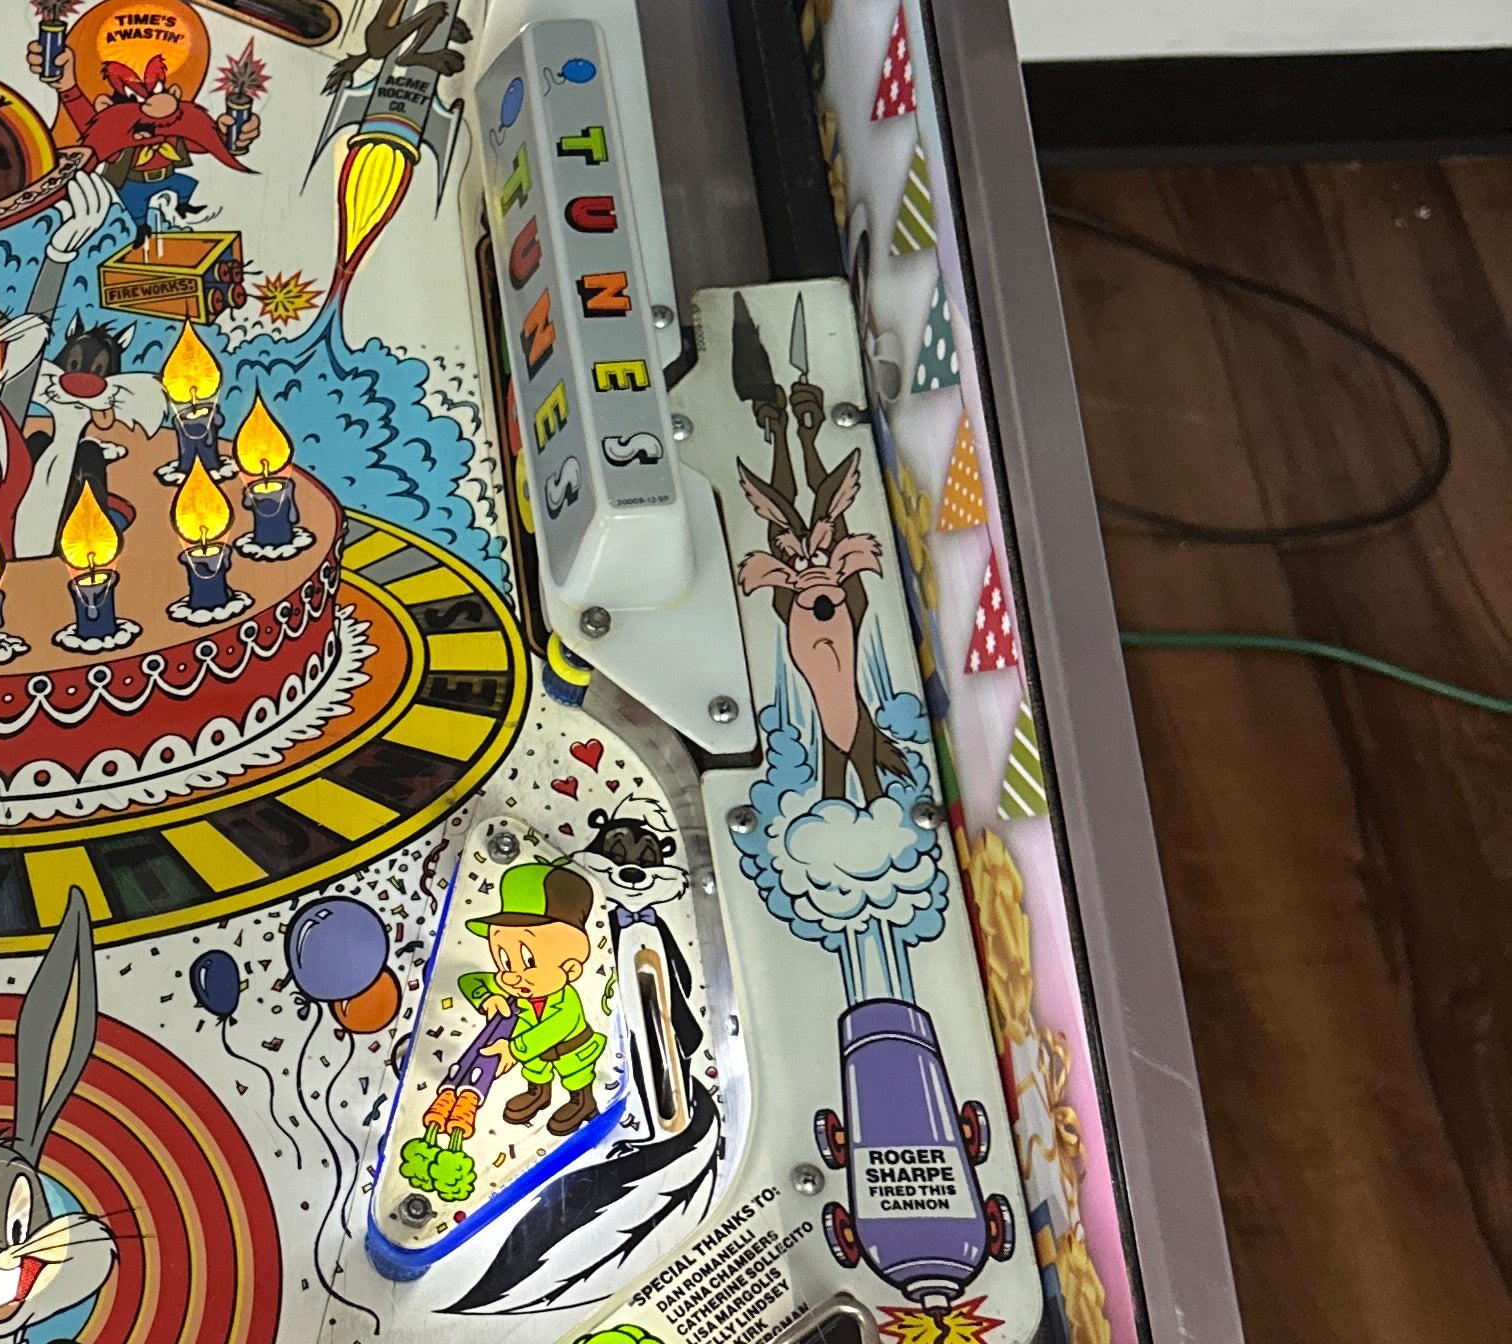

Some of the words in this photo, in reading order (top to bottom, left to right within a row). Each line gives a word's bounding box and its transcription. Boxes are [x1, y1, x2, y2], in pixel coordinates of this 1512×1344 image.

[115, 14, 177, 27] TIME'S
[378, 87, 430, 105] ROCKET
[385, 76, 430, 92] ACME
[557, 126, 664, 467] TUNES
[869, 1149, 945, 1165] ROGER
[866, 1167, 954, 1183] SHARPE
[869, 1185, 916, 1197] FIRED
[918, 1185, 956, 1196] THIS
[881, 1199, 949, 1211] CANNON
[633, 1255, 697, 1307] SPECIAL
[692, 1205, 755, 1256] THANKS
[751, 1187, 780, 1208] TO:
[655, 1285, 685, 1313] DAN
[685, 1229, 756, 1289] ROMANELLI
[666, 1286, 712, 1324] LUANA
[709, 1230, 779, 1289] CHAMBERS
[676, 1273, 748, 1335] CATHERINE
[747, 1221, 814, 1279] SOLLECITO
[715, 1267, 781, 1326] MARGOLIS
[737, 1279, 790, 1328] LINDSEY
